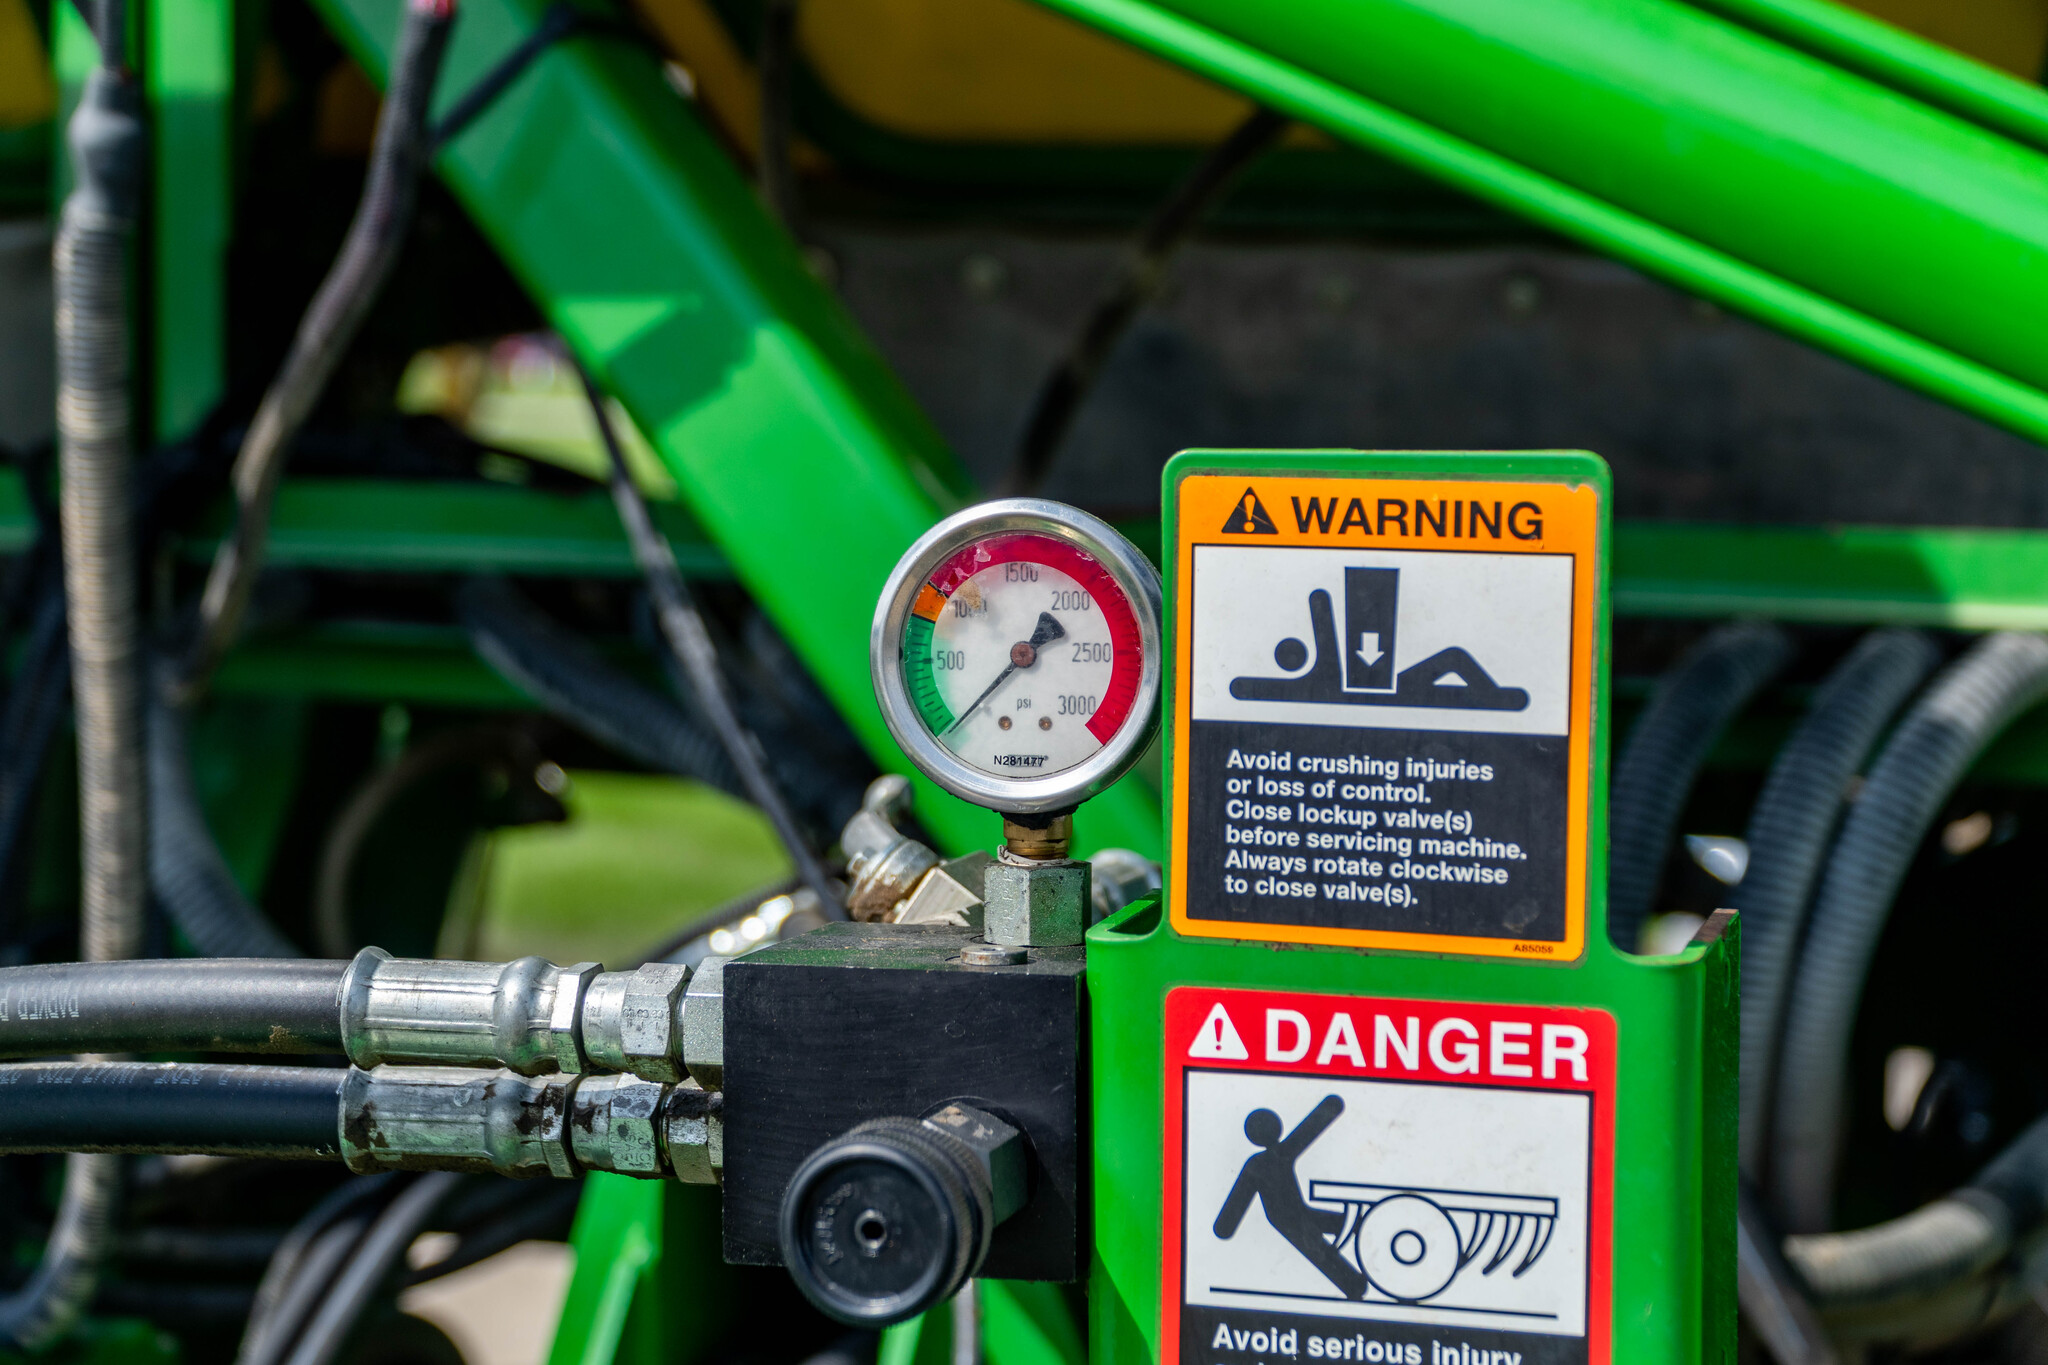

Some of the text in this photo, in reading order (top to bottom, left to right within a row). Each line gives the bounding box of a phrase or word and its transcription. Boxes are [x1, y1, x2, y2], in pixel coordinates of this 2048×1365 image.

[1290, 496, 1542, 540] WARNING
[1005, 562, 1039, 583] 1500
[1050, 591, 1090, 611] 2000
[937, 651, 965, 671] 500
[1071, 642, 1111, 663] 2500
[1016, 696, 1032, 710] psi
[1057, 695, 1096, 715] 3000
[993, 755, 1045, 767] N281477
[1226, 748, 1494, 783] Avoid crushing injuries
[1226, 775, 1432, 804] or loss of control.
[1226, 799, 1473, 836] Close lockup valve(s)
[1226, 823, 1527, 860] before servicing machine.
[1225, 848, 1509, 885] Always rotate clockwise
[1225, 874, 1418, 908] to close valve(s).
[1265, 1008, 1590, 1082] DANGER
[1212, 1323, 1297, 1355] Avoid
[1307, 1333, 1422, 1365] serious
